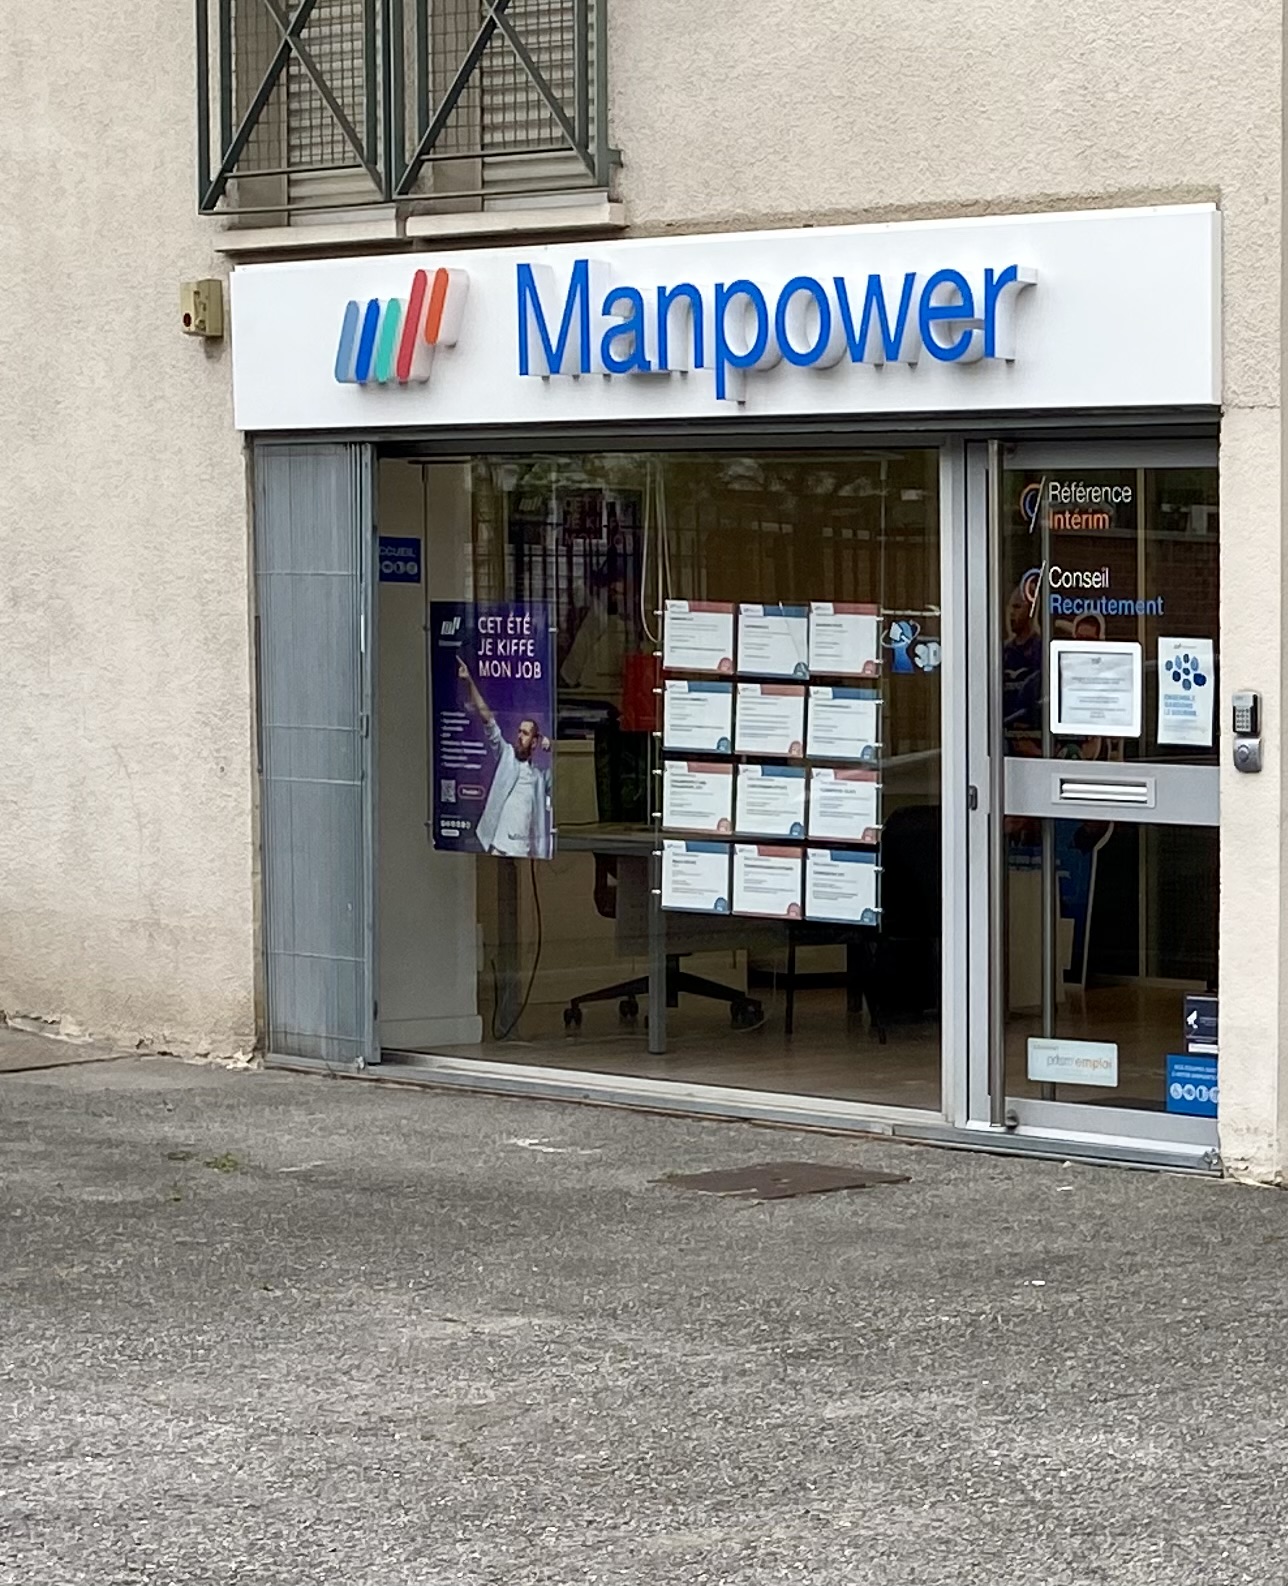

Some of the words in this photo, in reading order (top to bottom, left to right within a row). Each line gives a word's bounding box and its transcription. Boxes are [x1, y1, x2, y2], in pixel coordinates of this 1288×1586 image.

[516, 259, 1021, 401] Manpower
[1048, 481, 1132, 503] Référence
[1049, 508, 1110, 529] Intérim
[1048, 566, 1109, 588] Conseil
[1049, 594, 1164, 616] Recrutement
[477, 616, 502, 634] CET
[507, 611, 531, 635] ÉTÉ
[477, 638, 493, 656] JE
[497, 639, 535, 657] KIFFE
[478, 660, 512, 677] MON
[515, 661, 542, 679] JOB
